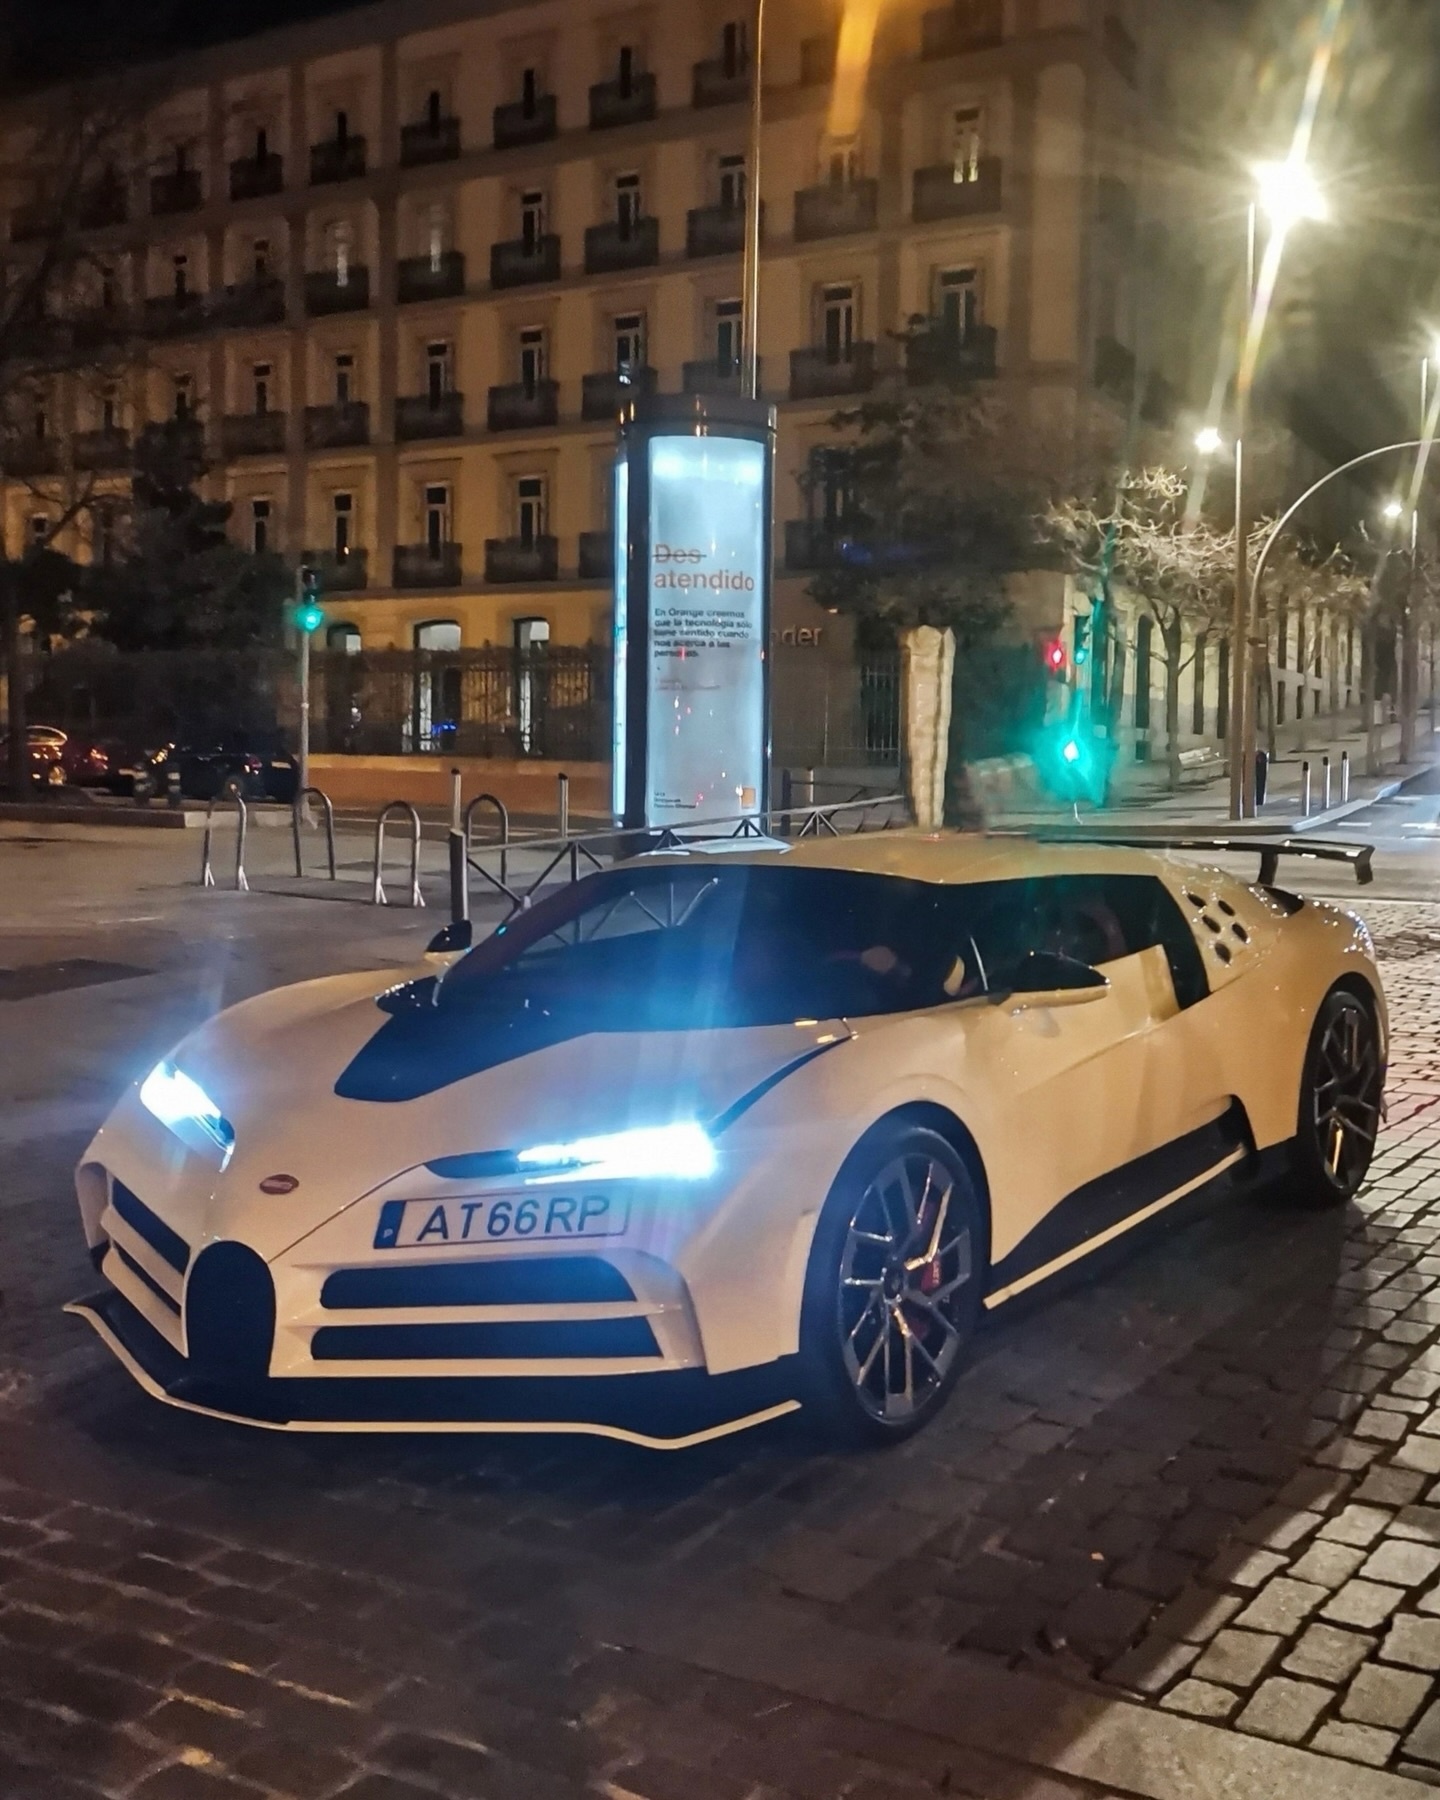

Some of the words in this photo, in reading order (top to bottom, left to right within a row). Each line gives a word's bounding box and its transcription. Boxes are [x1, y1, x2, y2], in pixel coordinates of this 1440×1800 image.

[654, 543, 702, 564] Des
[654, 569, 755, 592] atendido
[654, 607, 667, 617] En
[668, 607, 704, 618] Orange
